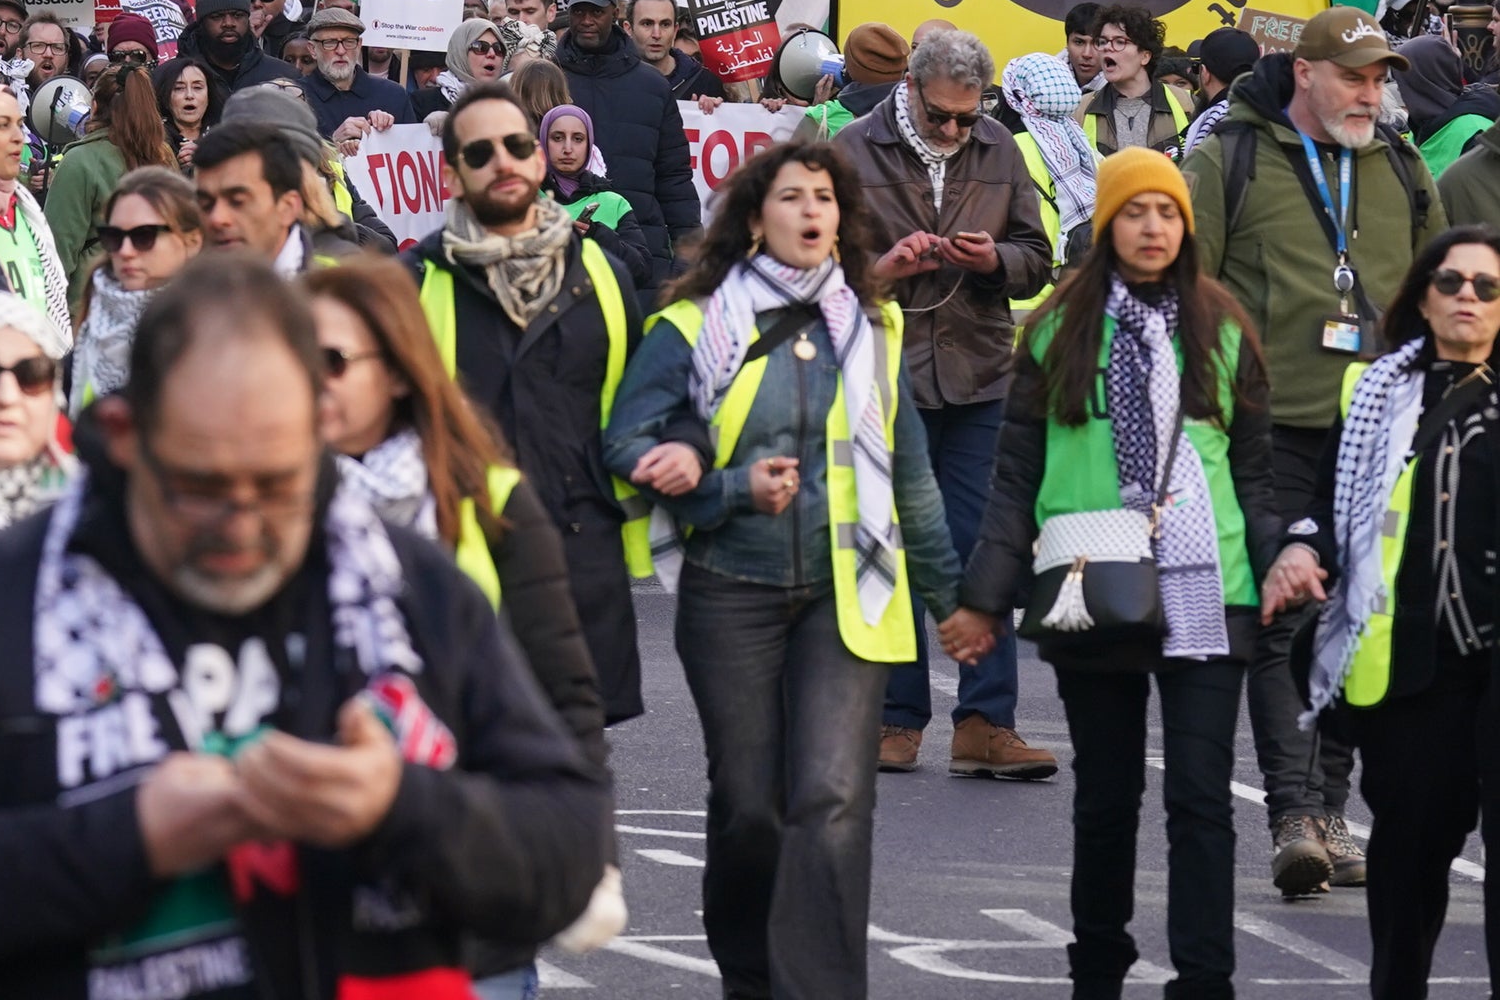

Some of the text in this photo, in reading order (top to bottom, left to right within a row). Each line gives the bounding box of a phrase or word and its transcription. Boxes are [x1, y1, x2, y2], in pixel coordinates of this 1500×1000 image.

[724, 0, 737, 11] for
[381, 22, 395, 31] Stop
[395, 23, 405, 31] the
[418, 25, 444, 33] coalition
[696, 1, 771, 36] PALESTINE
[716, 31, 764, 56] الحرية
[718, 46, 775, 76] لفلسطين
